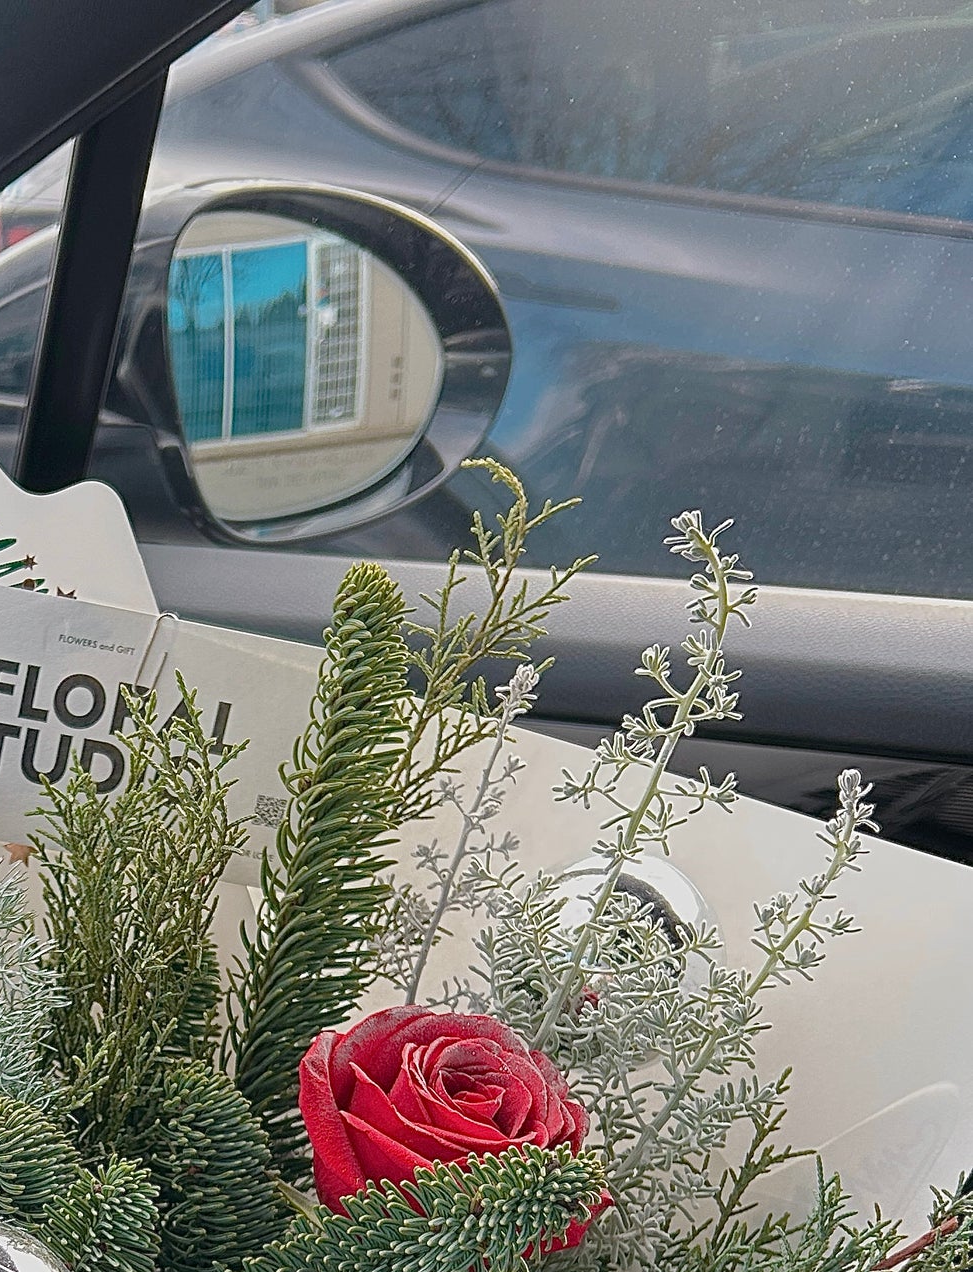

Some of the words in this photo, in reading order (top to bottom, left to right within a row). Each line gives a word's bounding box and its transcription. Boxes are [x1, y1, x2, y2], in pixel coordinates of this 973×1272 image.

[58, 633, 98, 649] FLOWERS
[99, 643, 115, 652] and
[116, 645, 136, 656] GIFT
